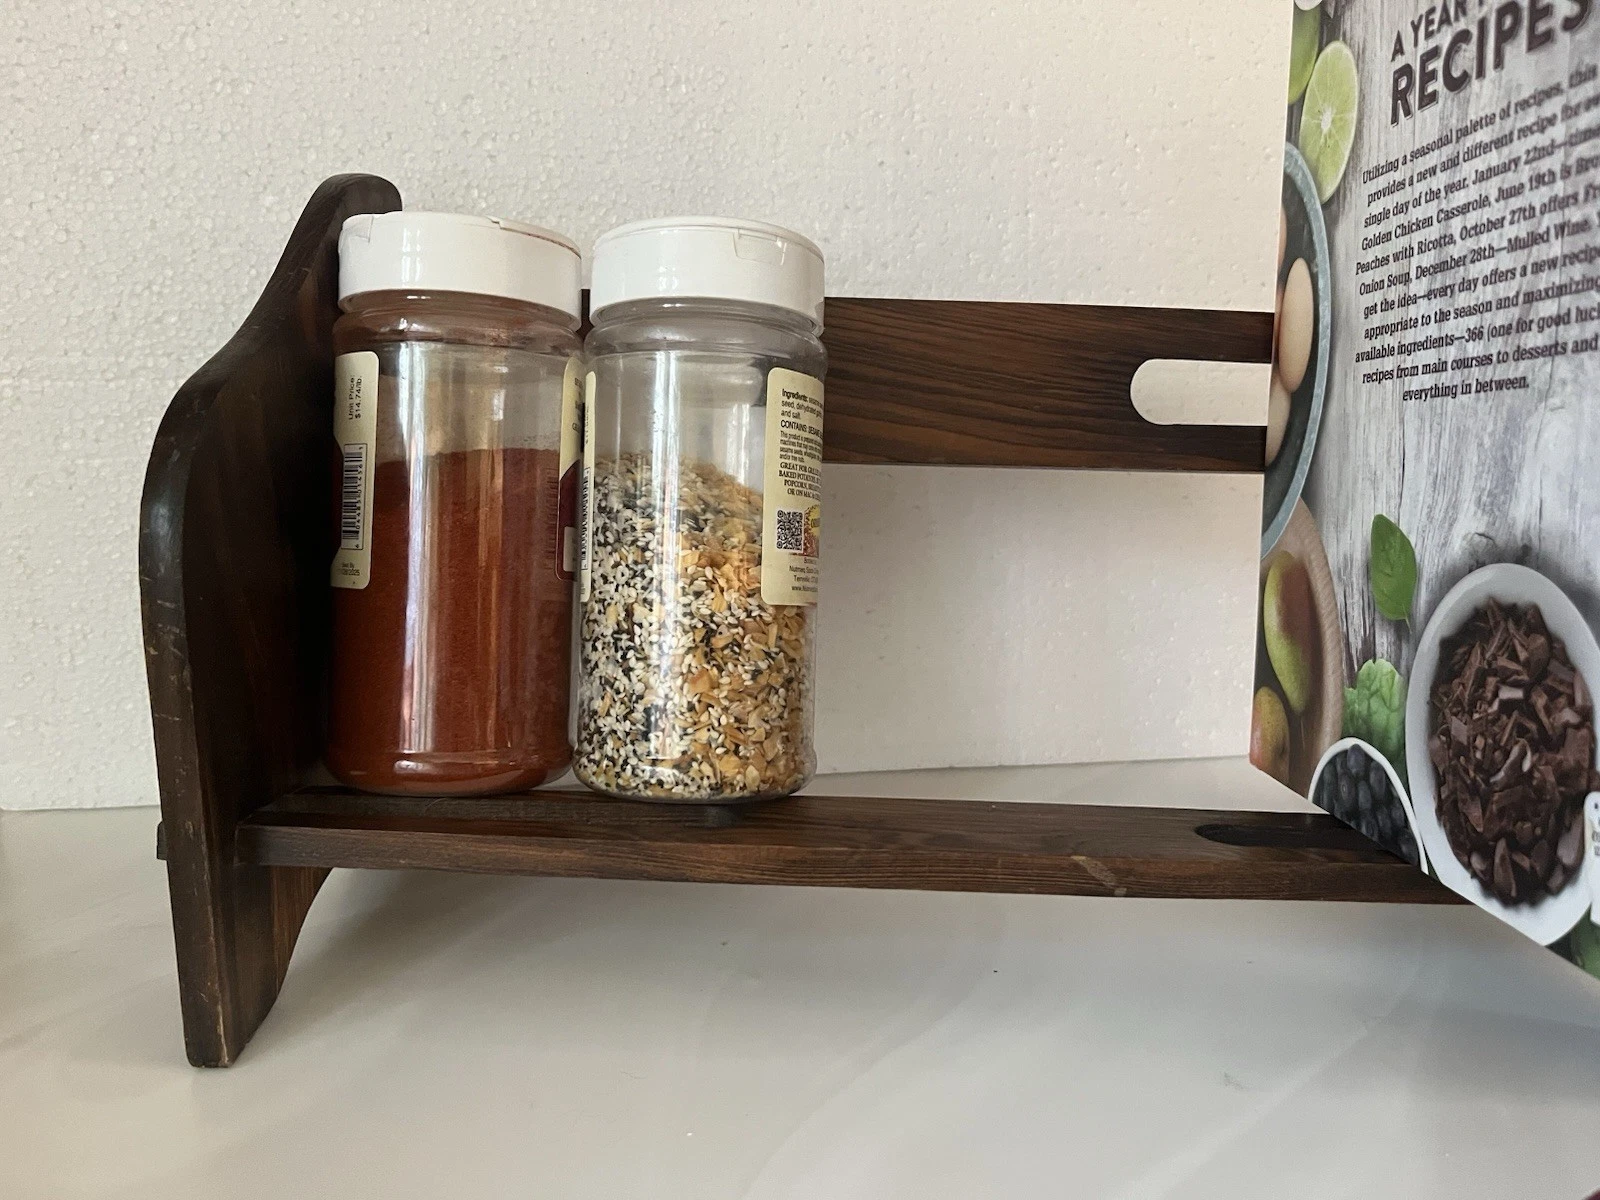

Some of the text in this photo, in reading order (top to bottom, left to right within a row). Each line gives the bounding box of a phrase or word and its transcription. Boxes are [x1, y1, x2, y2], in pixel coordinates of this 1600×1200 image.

[1391, 0, 1467, 62] A YEAR
[1362, 158, 1399, 184] Utilizing
[1402, 154, 1407, 166] a
[1410, 128, 1453, 162] seasonal
[1455, 113, 1496, 144] palette
[1500, 101, 1511, 120] of
[1367, 178, 1406, 207] provides
[1408, 175, 1414, 187] a
[1416, 164, 1438, 183] new
[1440, 151, 1460, 173] and
[1462, 130, 1514, 163] different
[1516, 113, 1558, 140] recipe
[1561, 101, 1582, 122] for
[1362, 230, 1392, 251] Golden
[1394, 216, 1433, 239] Chicken
[1436, 193, 1491, 224] Casserole,
[1495, 182, 1524, 203] June
[1528, 168, 1556, 191] 19th
[1560, 164, 1572, 180] is
[1364, 207, 1391, 228] single
[1392, 202, 1410, 217] day
[1412, 191, 1422, 209] of
[1424, 188, 1441, 204] the
[1444, 177, 1469, 199] year.
[1472, 156, 1521, 185] January
[1355, 253, 1390, 276] Peaches
[1392, 244, 1414, 262] with
[1417, 232, 1456, 255] Ricotta,
[1460, 215, 1506, 241] October
[1509, 203, 1536, 226] 27th
[1540, 191, 1579, 216] offers
[1360, 278, 1385, 296] Onion
[1387, 271, 1413, 289] Soup,
[1415, 255, 1467, 280] December
[1363, 302, 1378, 319] get
[1380, 298, 1395, 313] the
[1458, 277, 1479, 293] day
[1482, 267, 1517, 287] offers
[1519, 264, 1527, 278] a
[1531, 256, 1559, 275] new
[1355, 344, 1395, 363] available
[1487, 322, 1513, 342] (one
[1515, 317, 1535, 334] for
[1537, 308, 1571, 333] good
[1364, 315, 1419, 340] appropriate
[1421, 313, 1431, 327] to
[1434, 308, 1451, 324] the
[1453, 300, 1492, 320] season
[1495, 290, 1520, 310] and
[1362, 332, 1599, 384] recipes from main courses to desserts and
[780, 410, 791, 418] and
[1402, 376, 1529, 402] everything in between.
[779, 469, 797, 479] BAKED
[780, 461, 798, 471] GREAT
[799, 464, 808, 473] FOR
[787, 487, 795, 496] OR
[795, 489, 803, 497] ON
